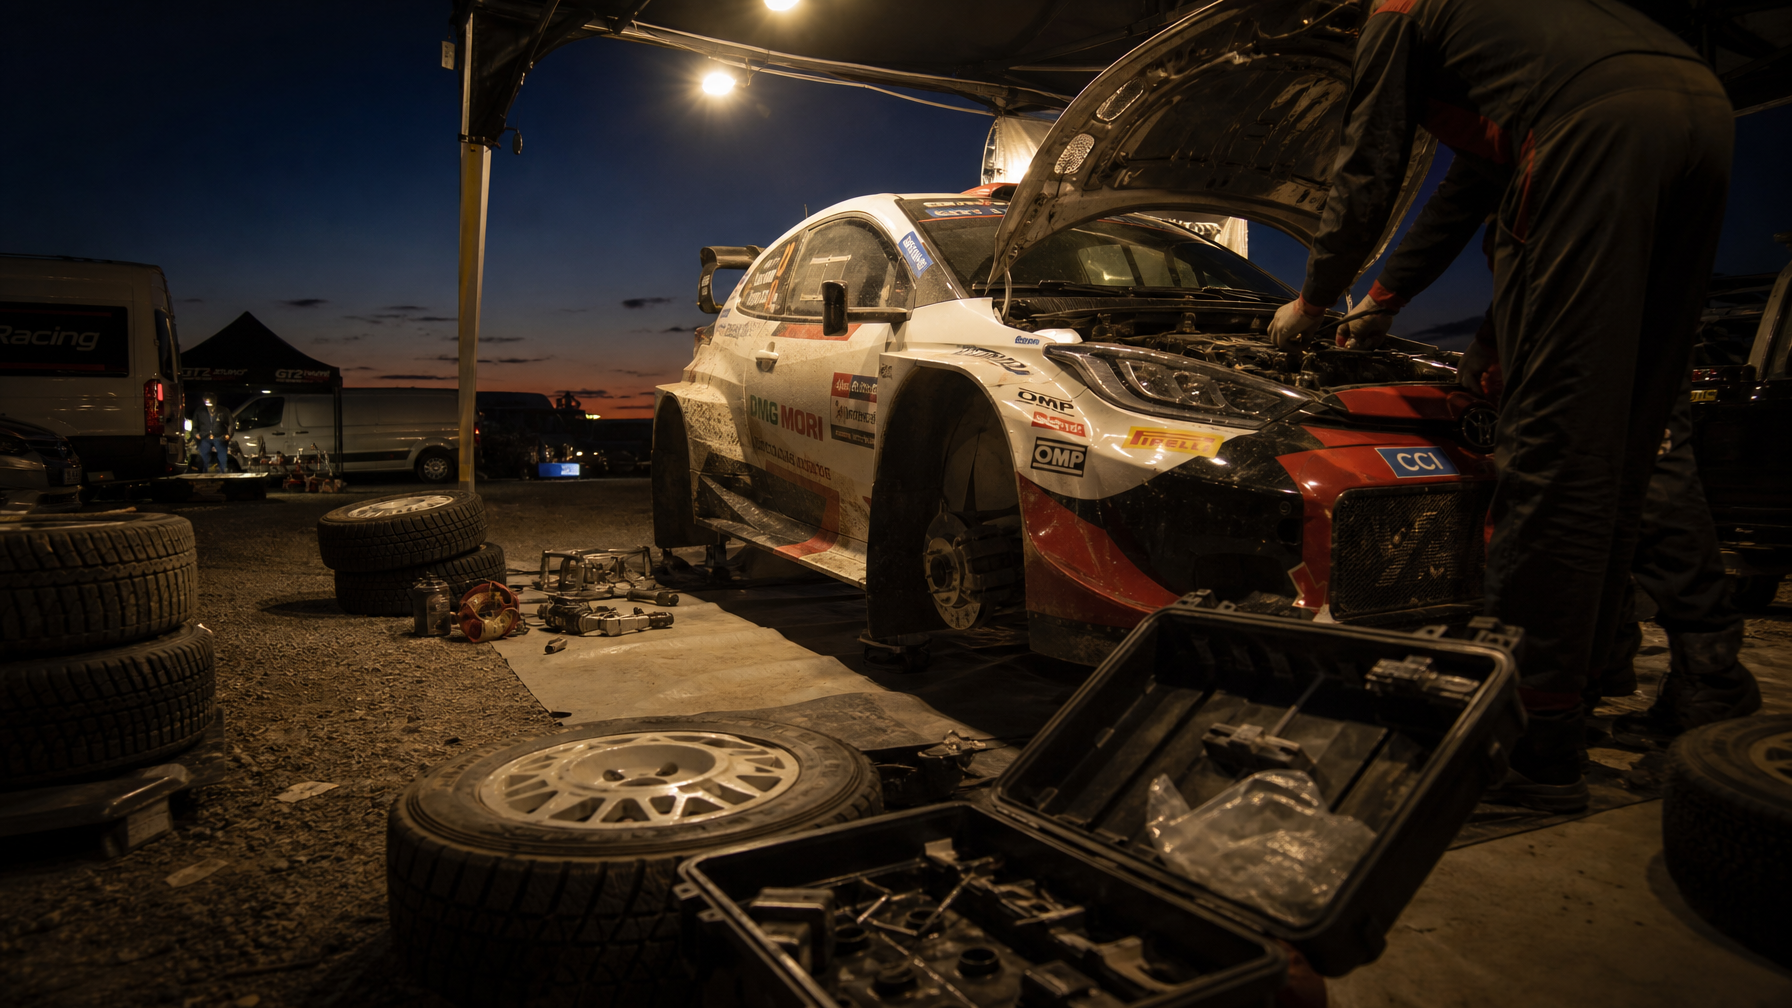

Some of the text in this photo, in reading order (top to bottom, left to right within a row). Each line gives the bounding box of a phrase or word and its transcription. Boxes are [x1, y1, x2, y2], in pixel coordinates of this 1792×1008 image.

[0, 324, 100, 352] Racing
[1018, 391, 1074, 411] OMP
[750, 394, 778, 425] DMG
[781, 404, 823, 442] MORI
[1130, 430, 1215, 452] PIRELLI
[1034, 445, 1085, 469] OMP
